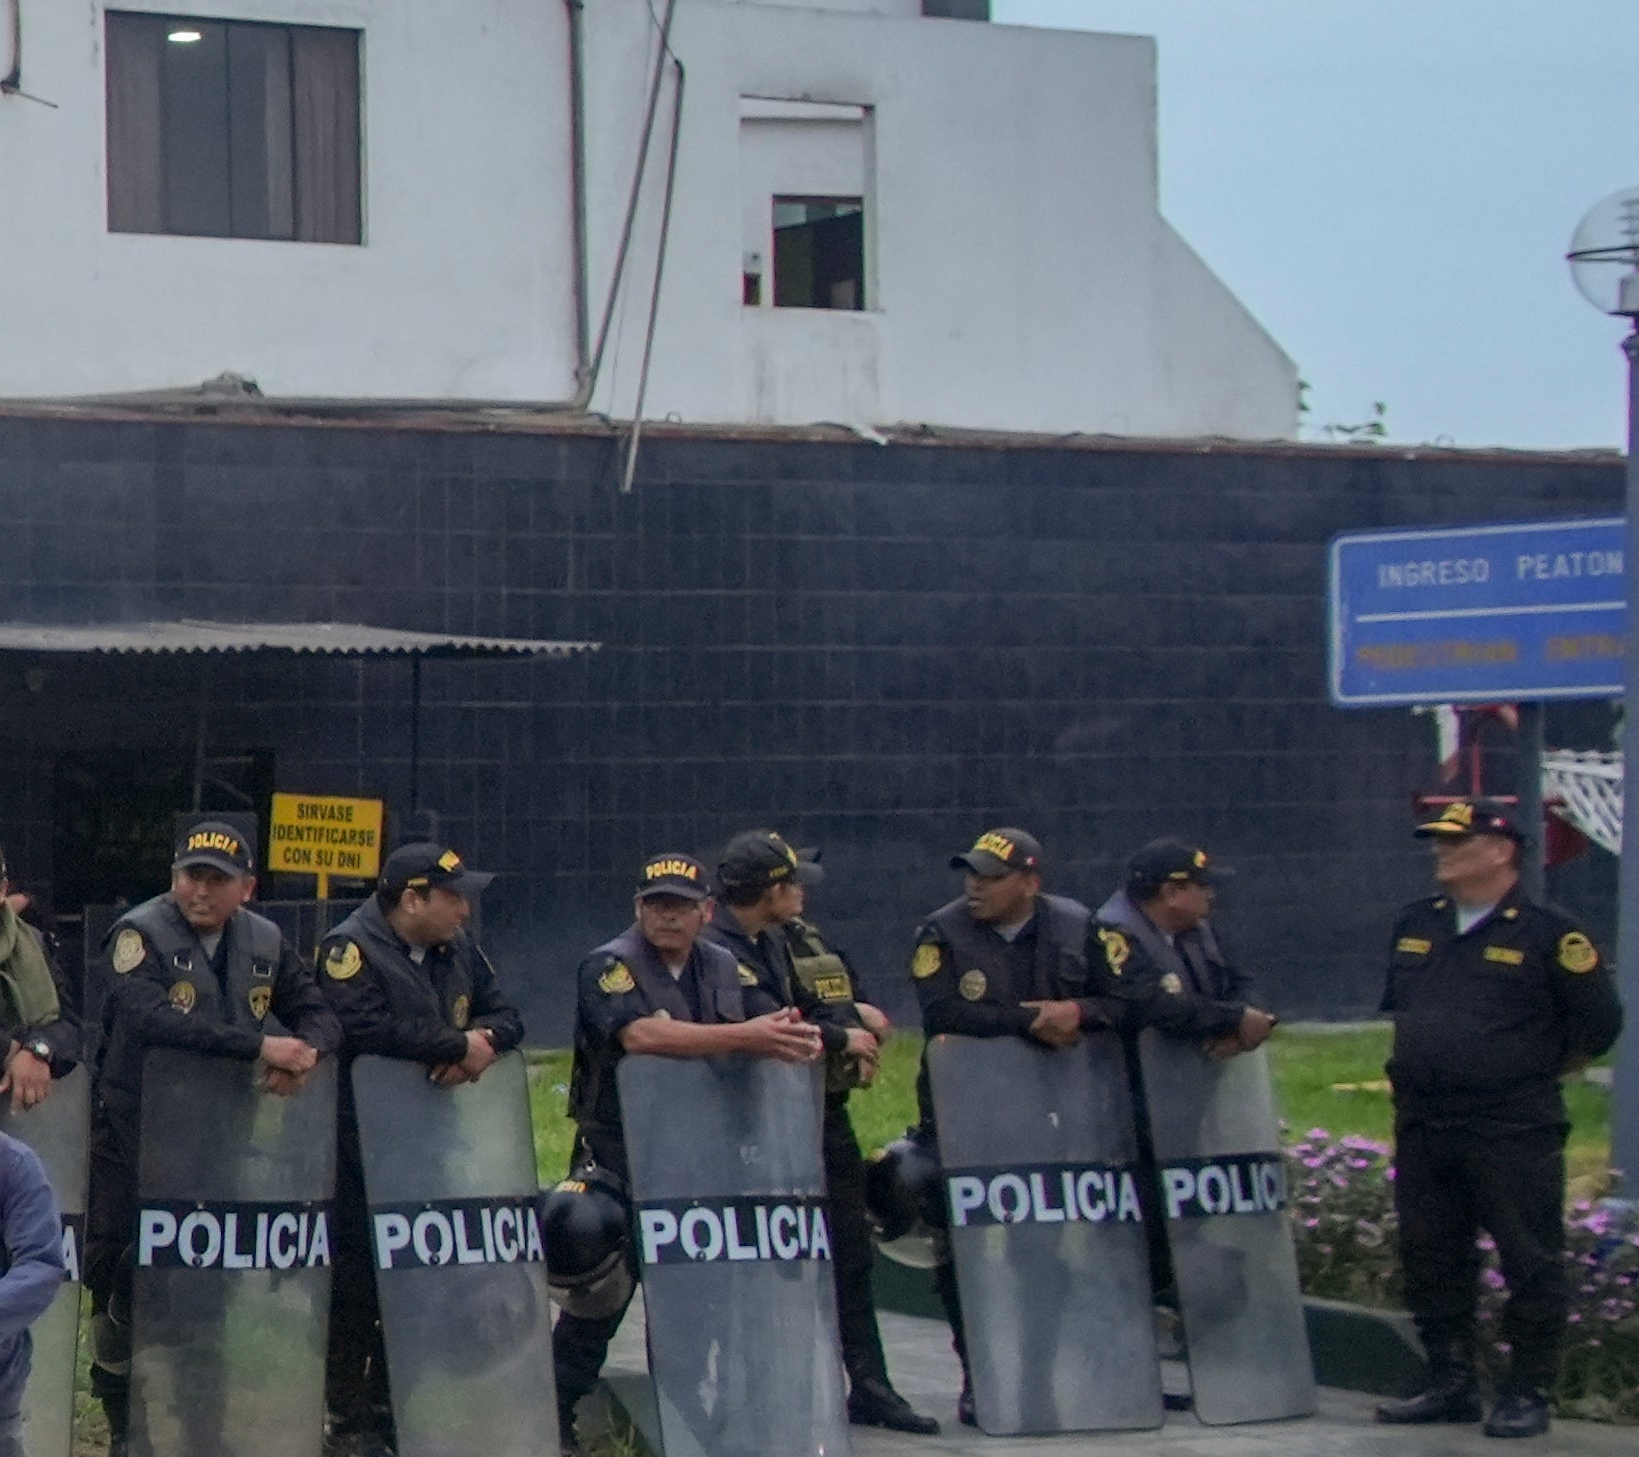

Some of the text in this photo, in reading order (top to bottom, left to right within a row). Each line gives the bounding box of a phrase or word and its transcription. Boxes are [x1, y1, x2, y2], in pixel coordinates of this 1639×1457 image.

[1379, 557, 1490, 588] INGRESO
[297, 803, 354, 823] SIRVASE
[187, 832, 239, 855] POLICIA
[273, 824, 374, 847] IDENTIFICARSE
[283, 847, 361, 868] CON SU DNI
[645, 859, 698, 881] POLICIA
[947, 1171, 1142, 1227] POLICIA
[139, 1209, 331, 1268] POLICIA
[373, 1206, 545, 1269] POLICIA
[638, 1205, 831, 1264] POLICIA
